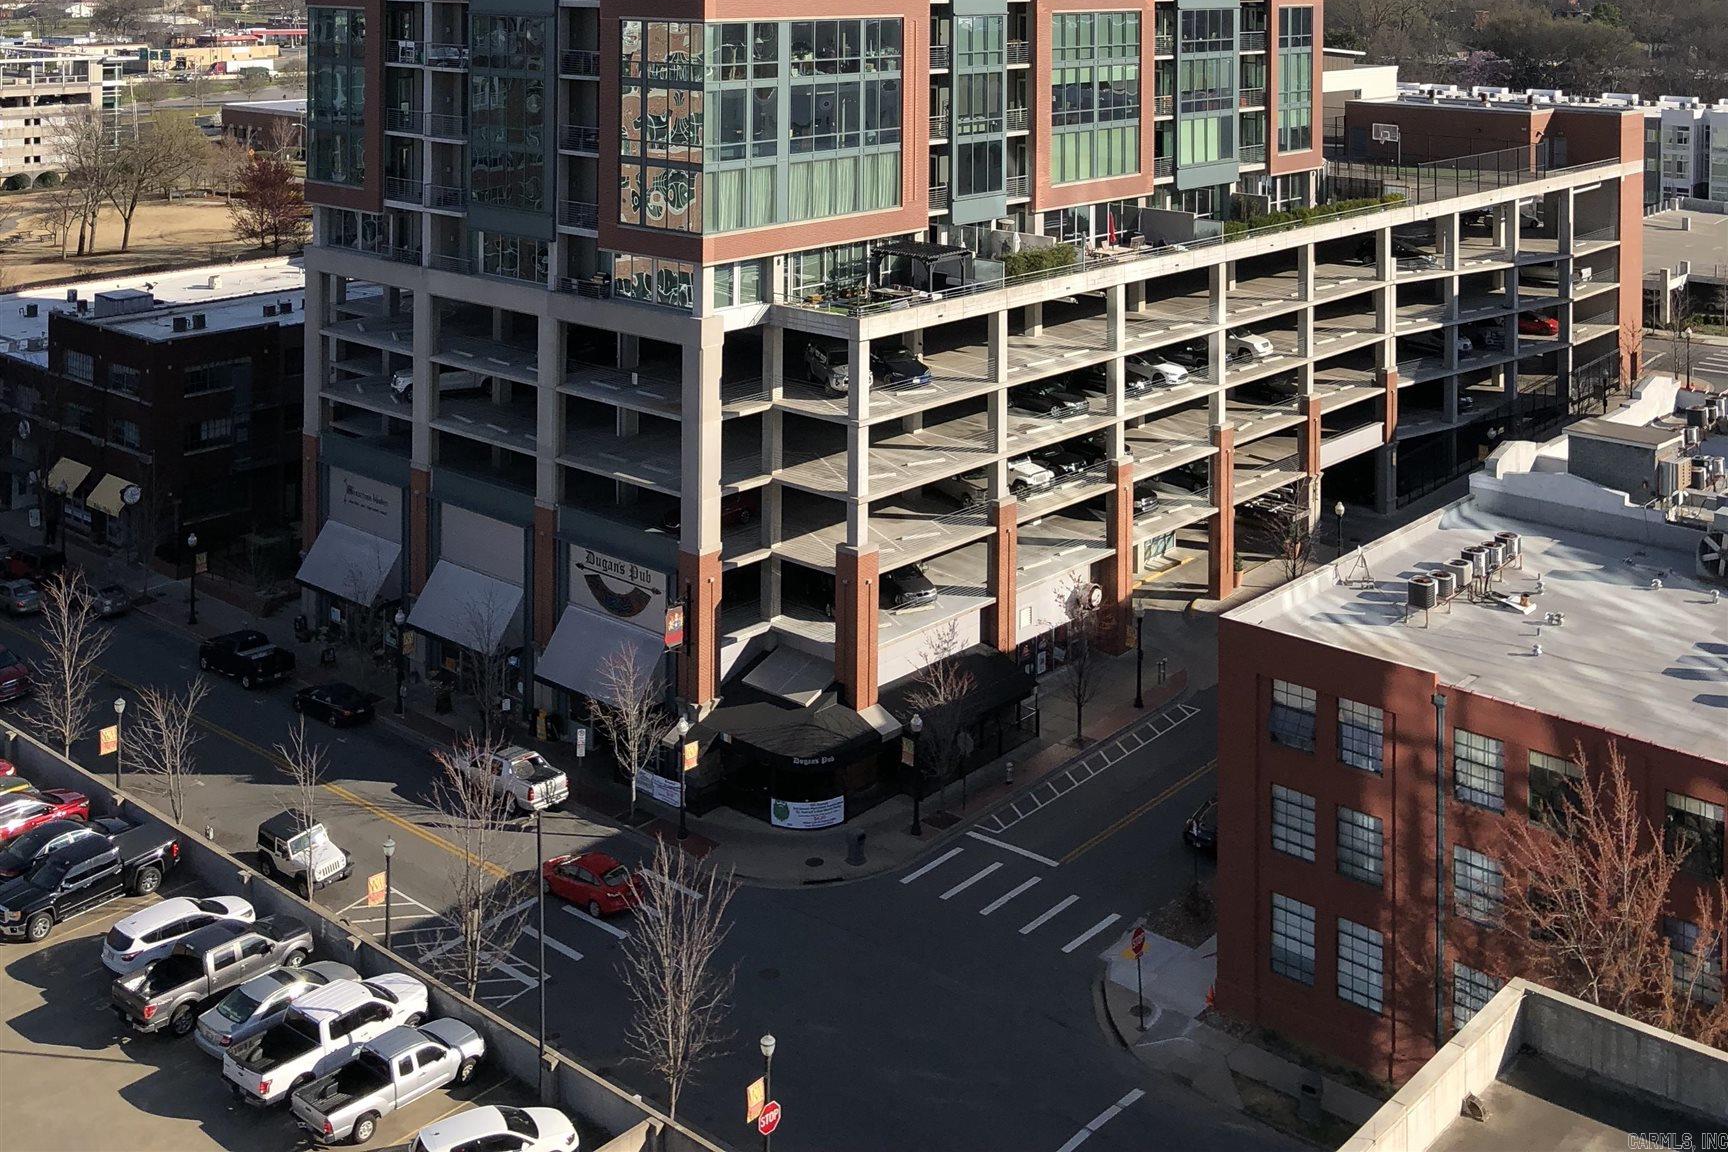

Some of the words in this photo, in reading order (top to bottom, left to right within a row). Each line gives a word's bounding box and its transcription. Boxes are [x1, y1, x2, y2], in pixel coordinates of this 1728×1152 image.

[585, 549, 625, 575] Dugan's
[629, 564, 652, 583] Pub
[1132, 932, 1145, 948] STOP
[760, 1108, 779, 1128] STOP
